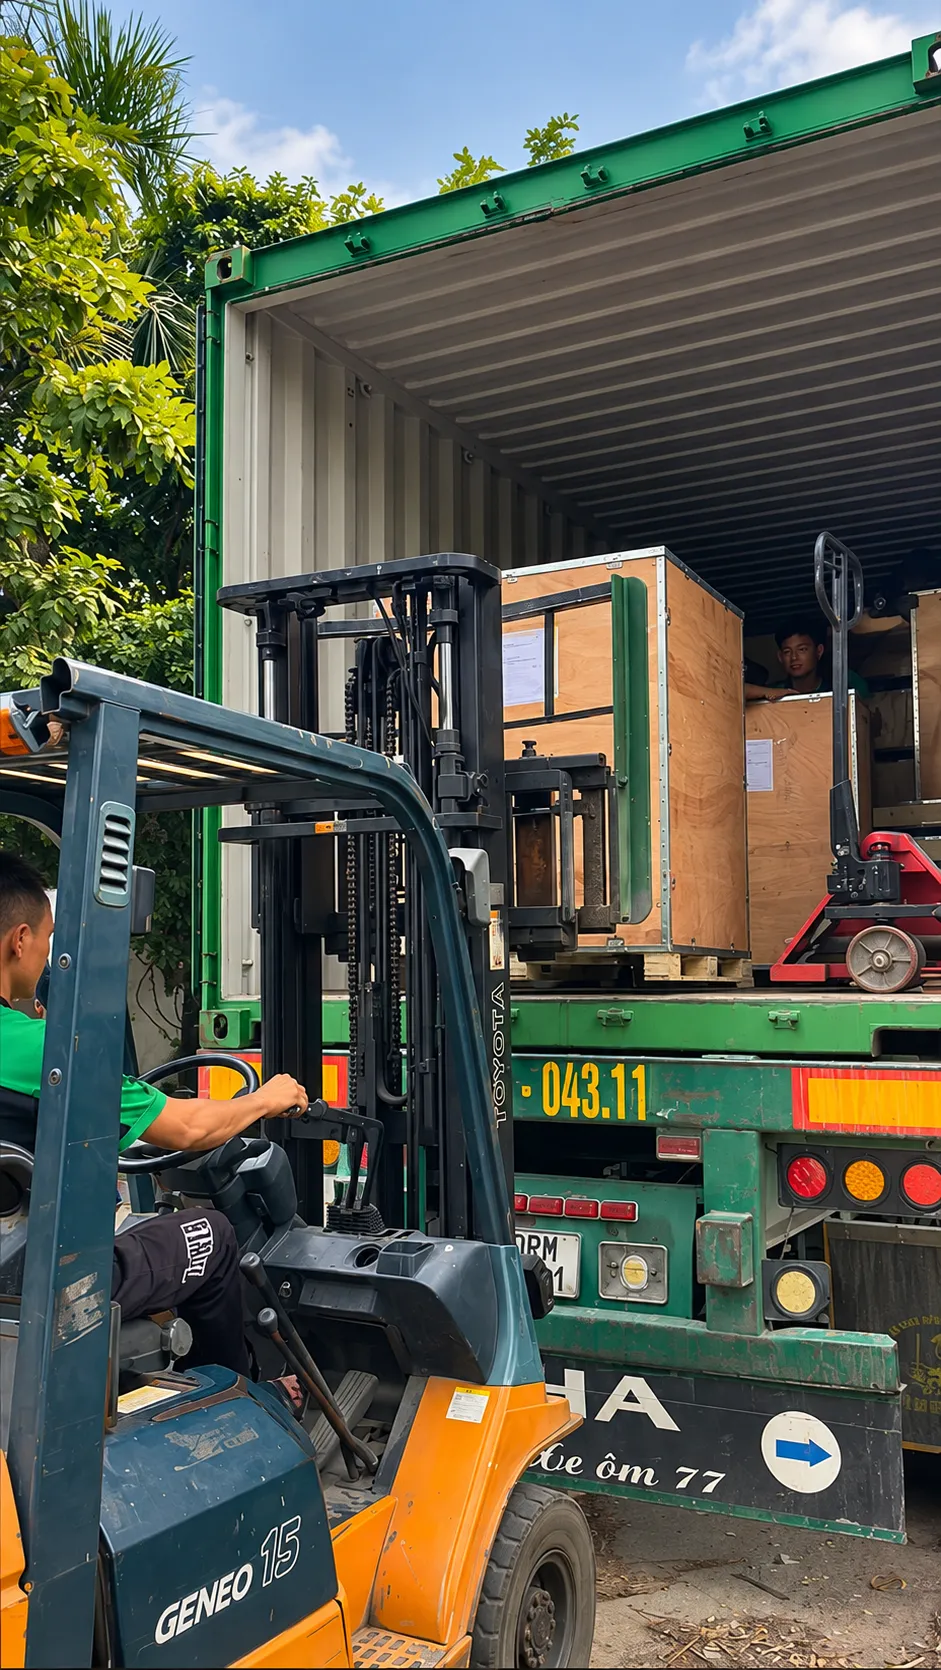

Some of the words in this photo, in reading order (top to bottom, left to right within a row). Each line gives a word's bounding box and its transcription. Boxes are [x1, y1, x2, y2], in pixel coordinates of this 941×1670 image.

[491, 981, 506, 1129] TOYOTA
[542, 1061, 647, 1121] 043.11
[595, 1452, 660, 1487] ôm
[675, 1465, 726, 1494] 77
[154, 1563, 254, 1645] GENEO
[260, 1515, 302, 1588] 15
